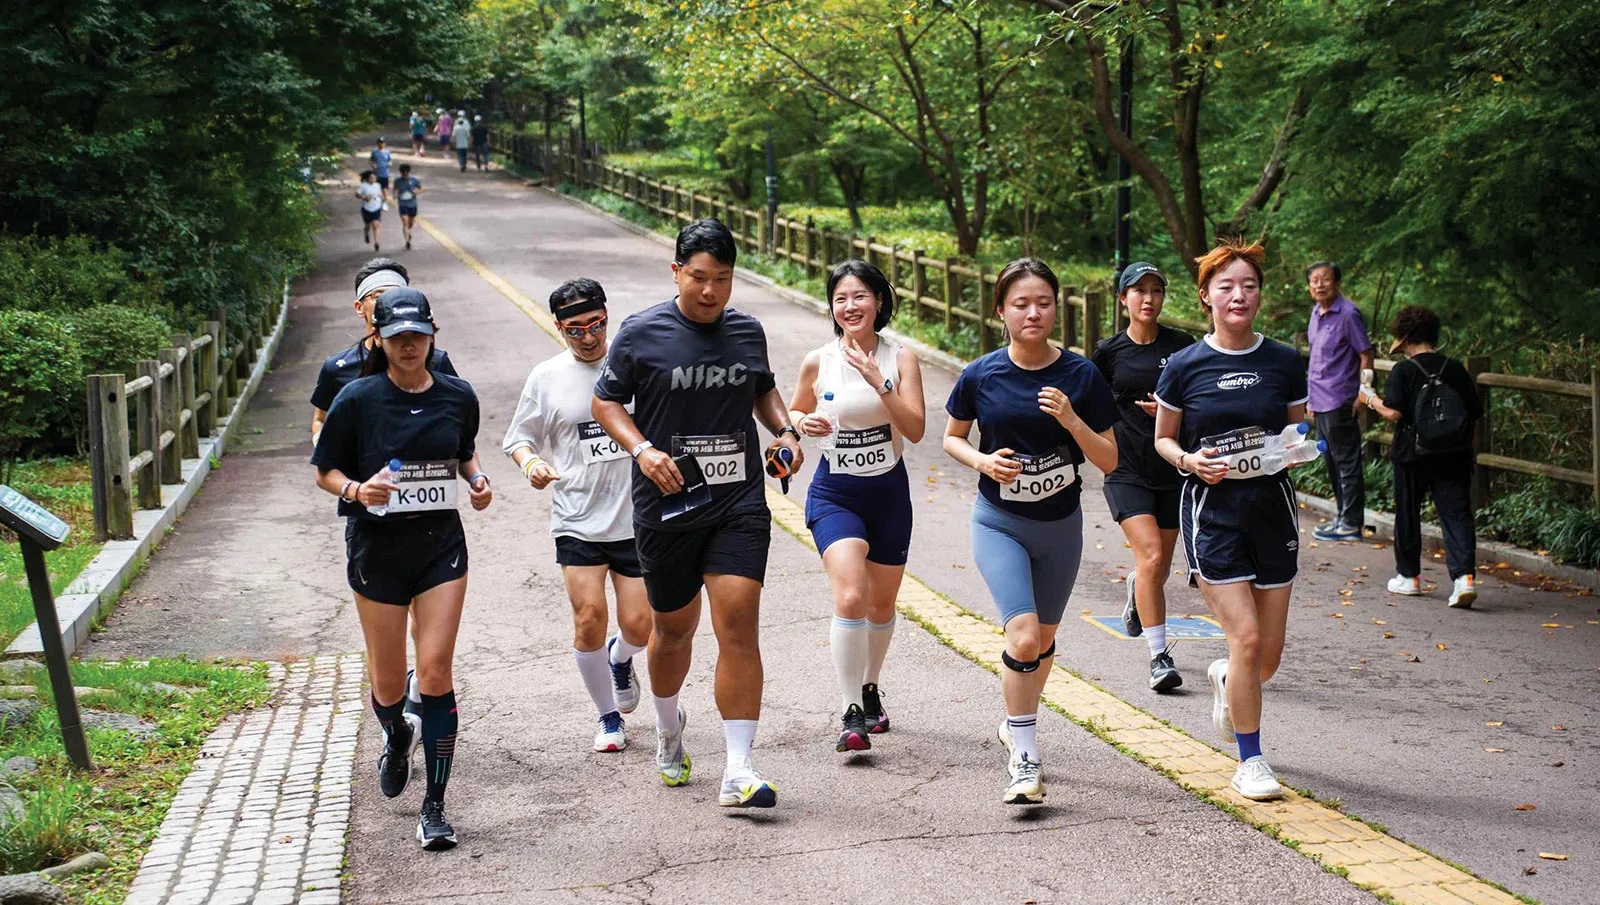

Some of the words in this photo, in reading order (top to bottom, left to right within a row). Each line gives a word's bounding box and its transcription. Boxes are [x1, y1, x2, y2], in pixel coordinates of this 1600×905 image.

[670, 362, 748, 391] NIRC
[590, 440, 625, 457] K-0
[700, 445, 713, 453] 서울
[849, 437, 862, 445] 서울
[1230, 440, 1244, 451] 서울
[837, 448, 886, 468] K-005
[412, 469, 425, 478] 서울
[703, 460, 737, 478] 002
[1009, 474, 1065, 496] J-002
[397, 486, 446, 505] K-001
